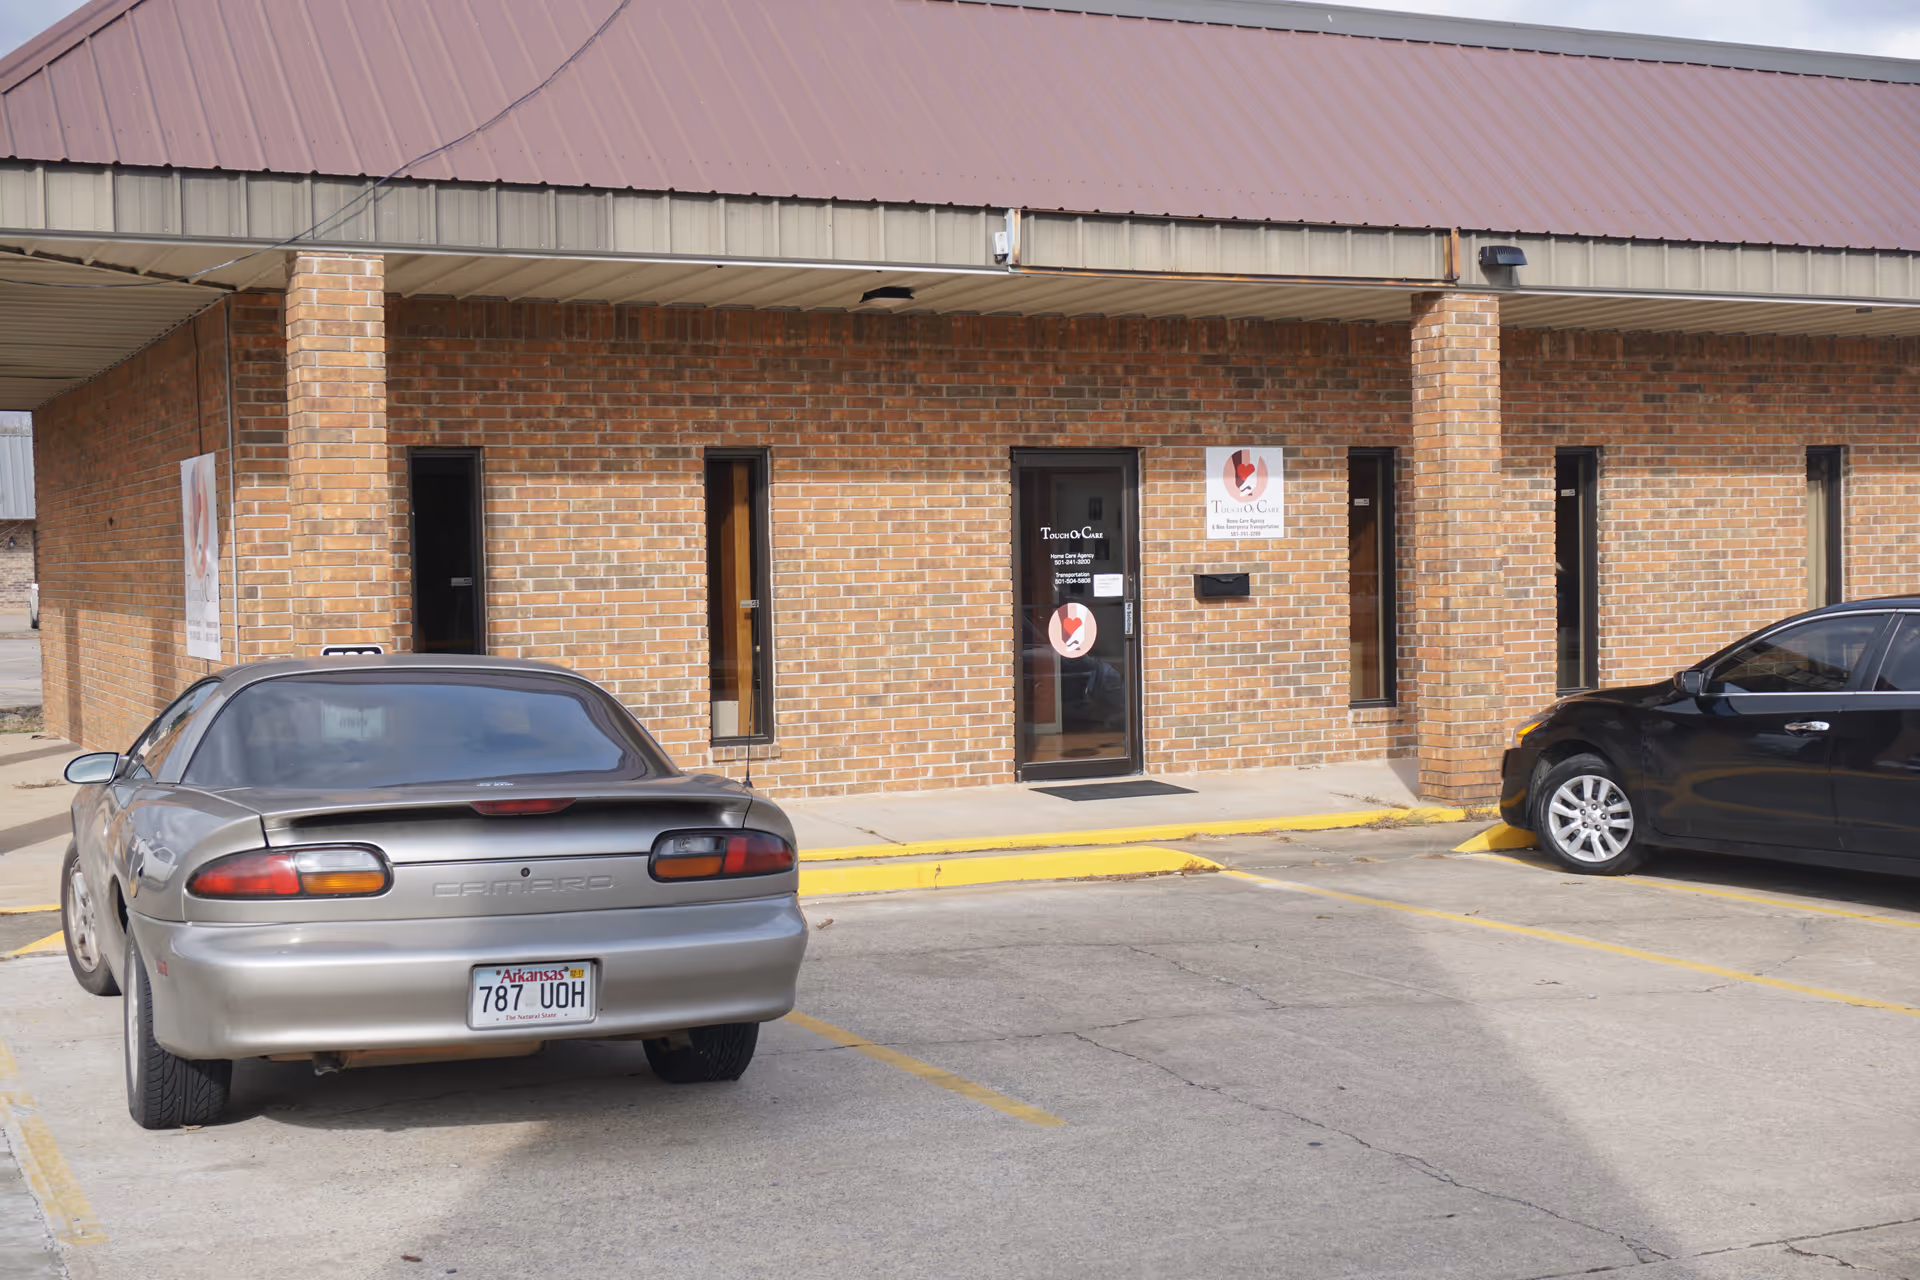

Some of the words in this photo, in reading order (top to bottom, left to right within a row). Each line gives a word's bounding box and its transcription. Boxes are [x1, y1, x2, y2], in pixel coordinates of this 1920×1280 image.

[433, 875, 614, 897] CAMARO
[500, 968, 565, 984] Arkansas
[479, 983, 524, 1013] 787
[540, 981, 585, 1010] UOH
